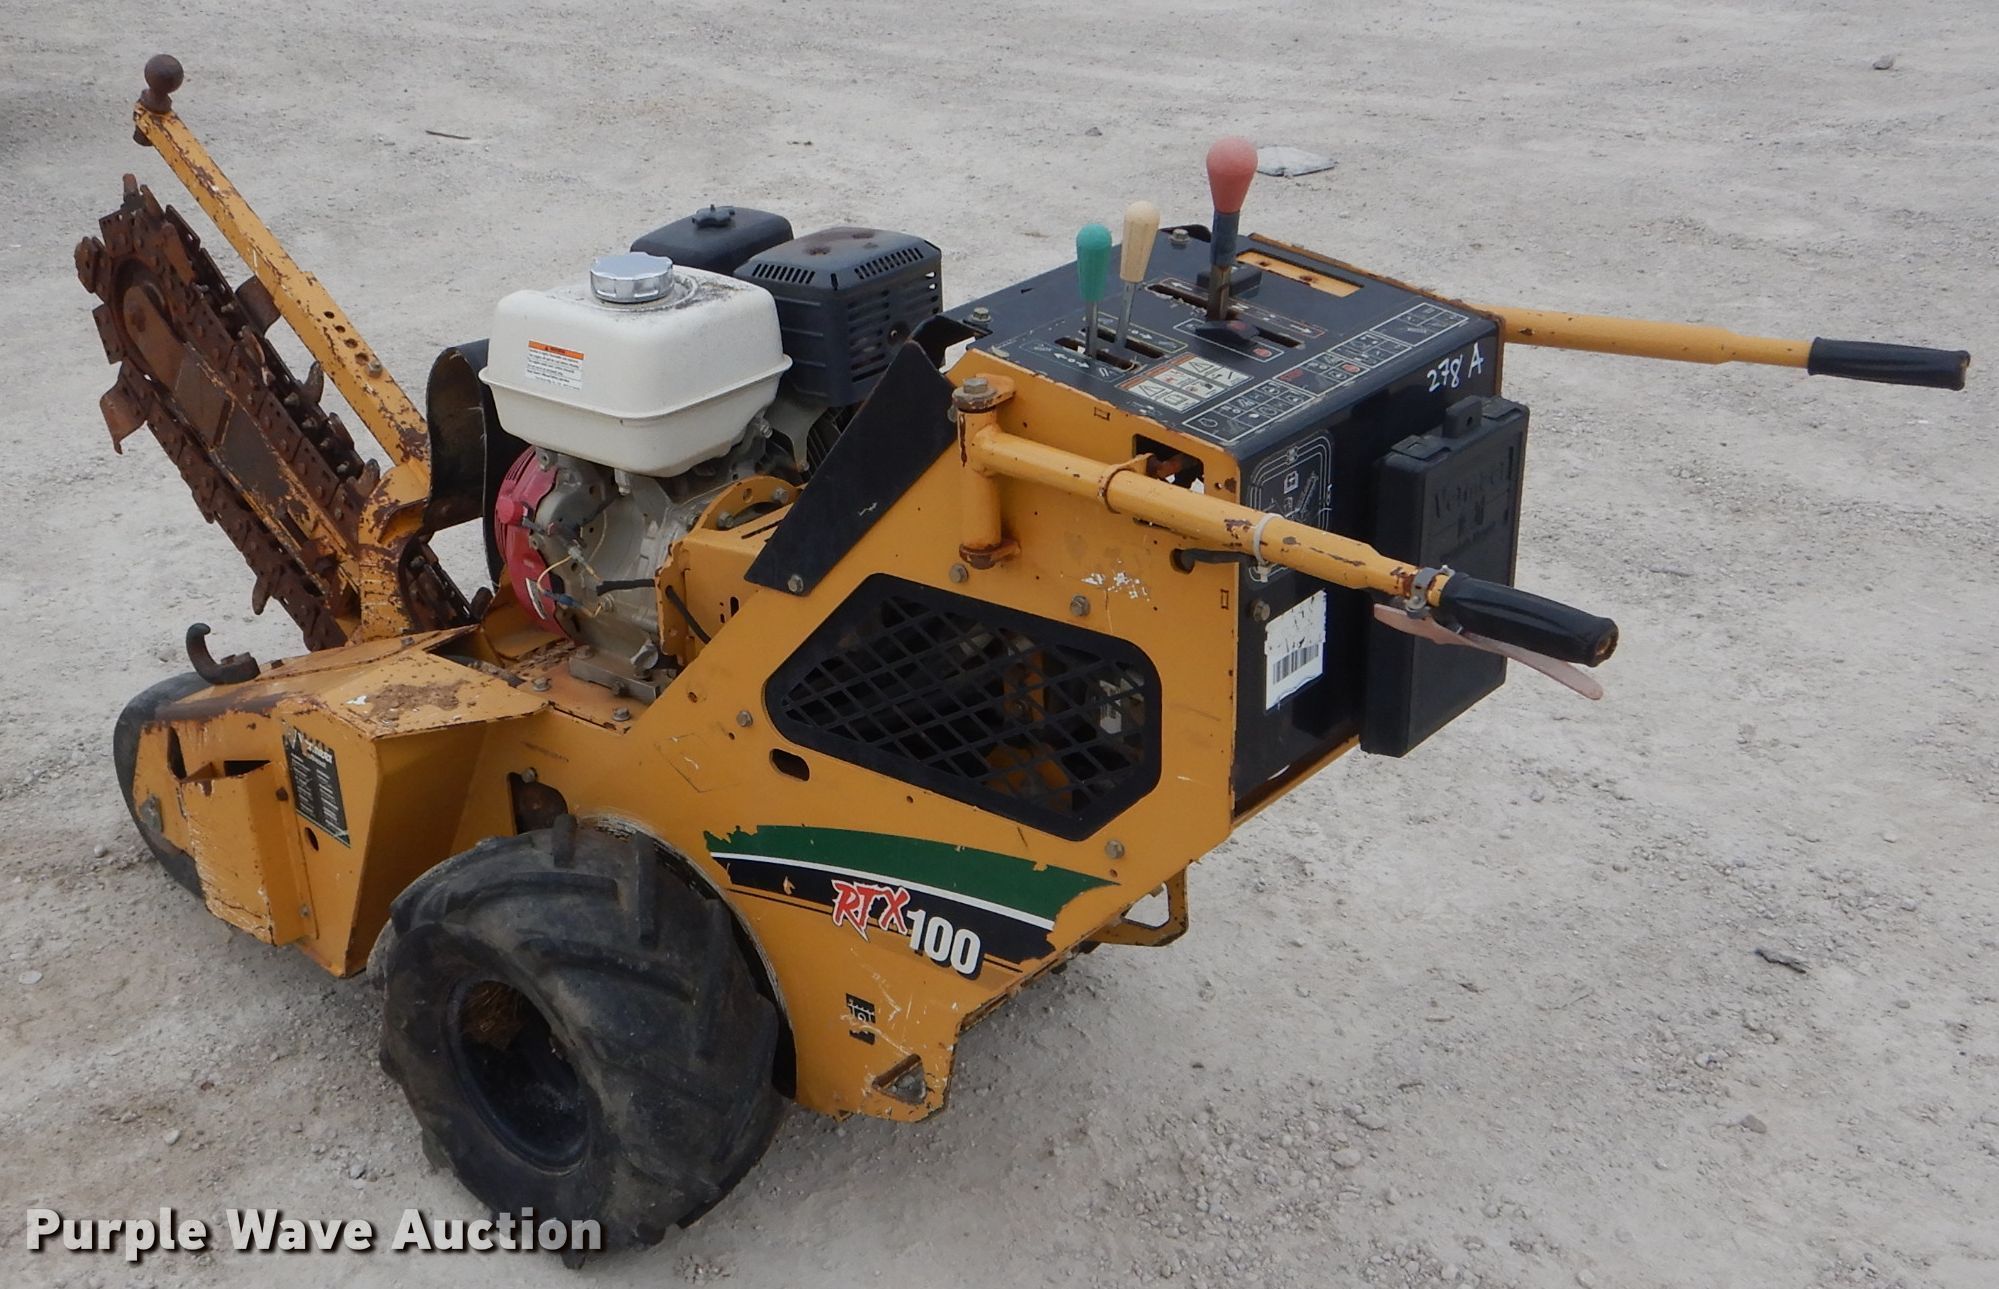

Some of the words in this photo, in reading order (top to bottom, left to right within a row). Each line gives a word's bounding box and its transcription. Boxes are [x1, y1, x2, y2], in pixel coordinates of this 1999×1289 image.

[1427, 354, 1463, 392] 278
[1468, 341, 1484, 378] A
[831, 879, 911, 942] RTX
[906, 909, 982, 976] 100
